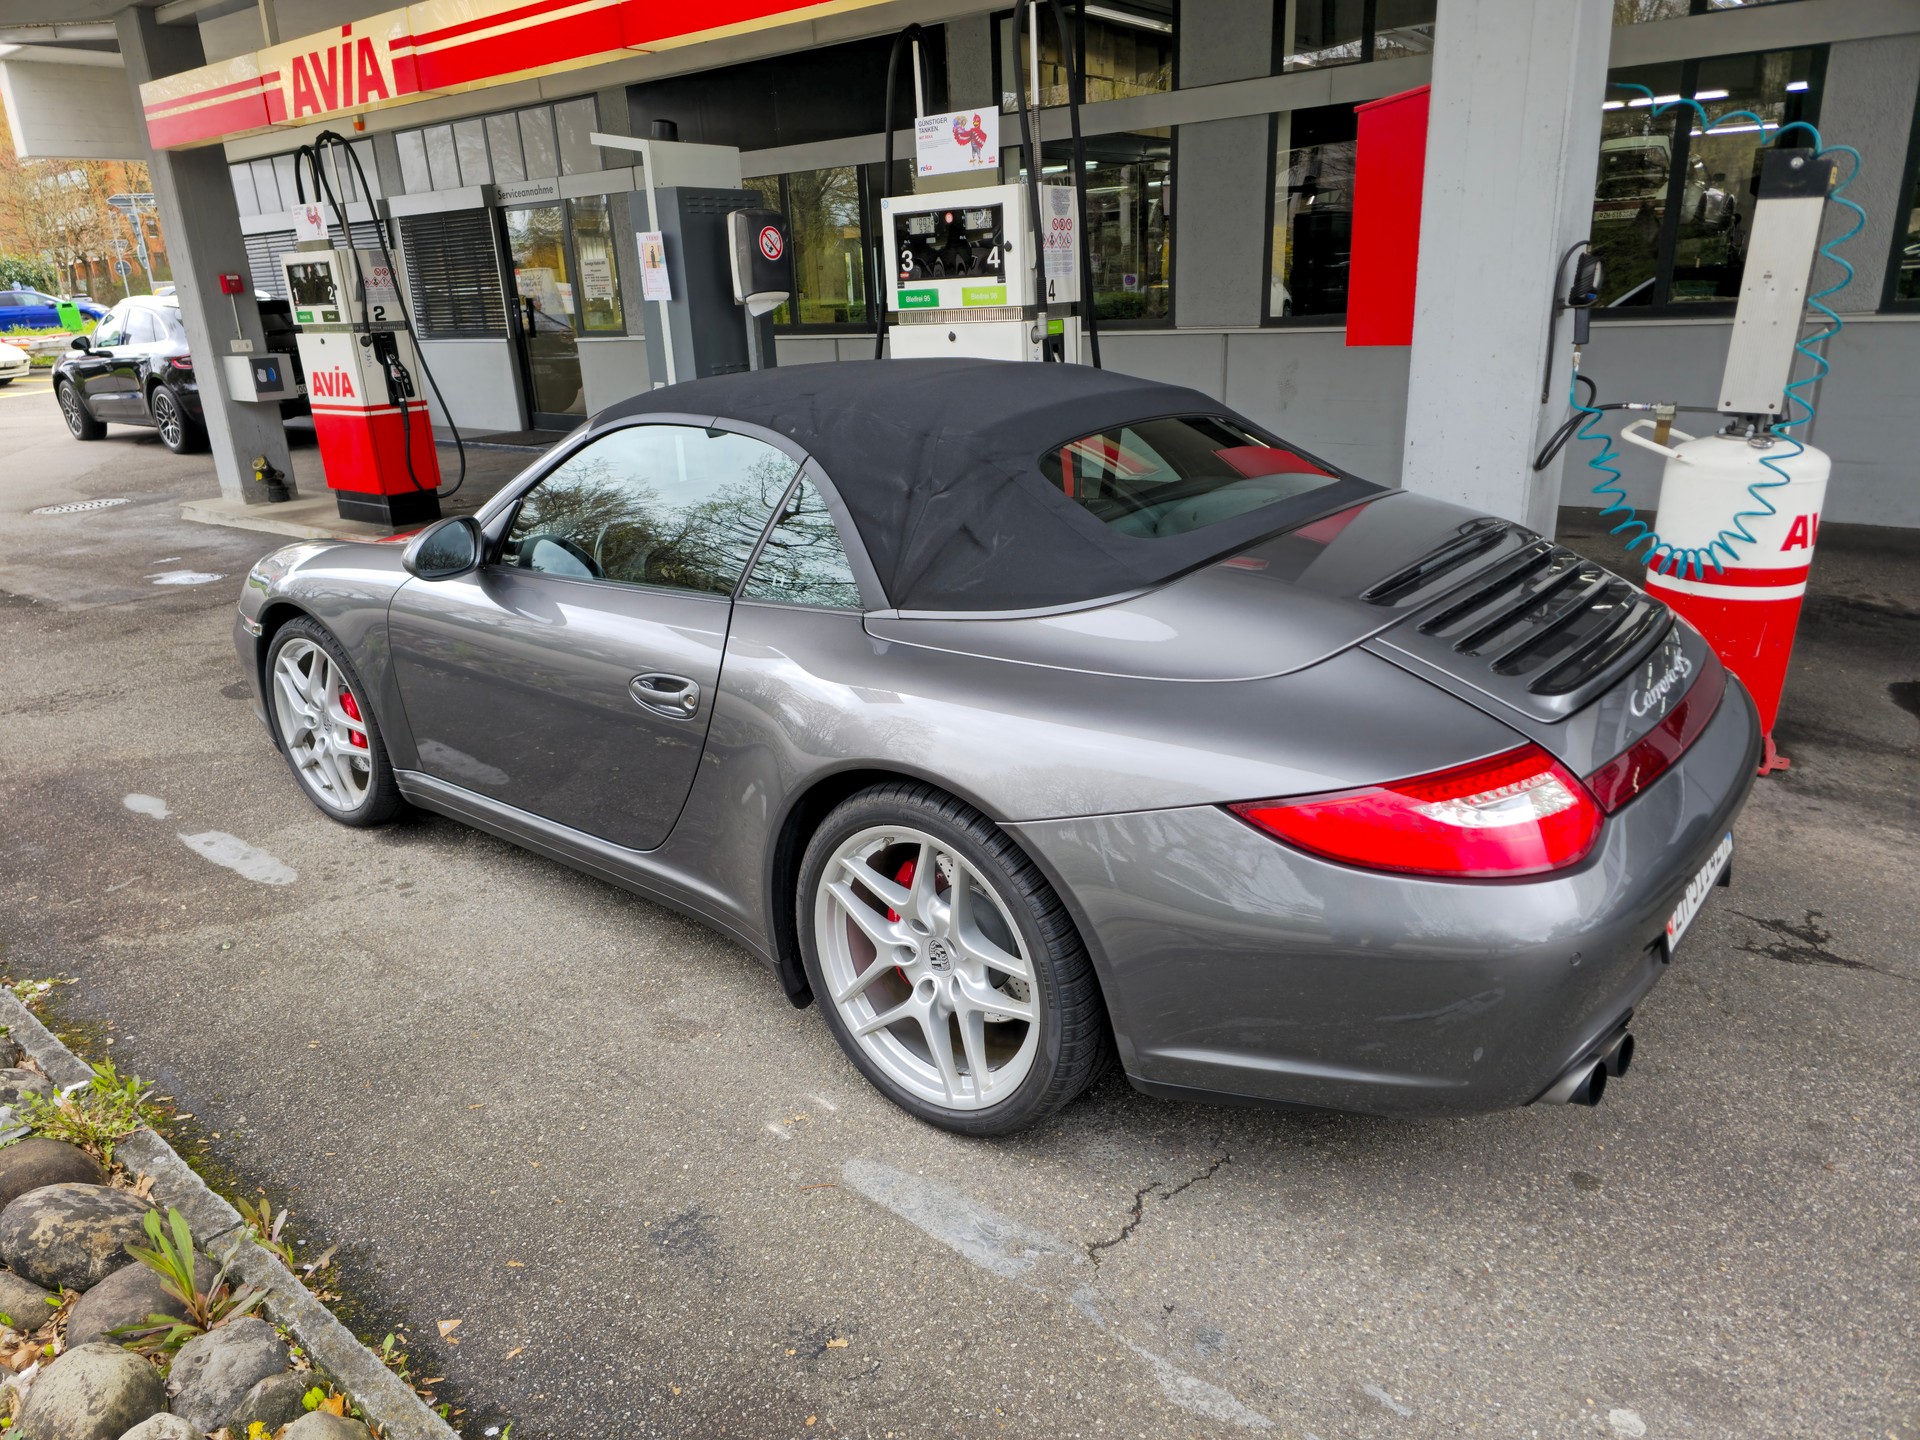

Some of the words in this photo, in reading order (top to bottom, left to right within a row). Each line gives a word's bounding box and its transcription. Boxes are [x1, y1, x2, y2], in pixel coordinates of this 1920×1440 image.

[292, 22, 390, 118] AVIA
[497, 184, 554, 200] Serviceannahme
[901, 250, 914, 271] 3
[987, 246, 1001, 268] 4
[293, 288, 299, 300] 1
[328, 286, 335, 300] 2
[1048, 279, 1056, 301] 4
[373, 305, 387, 321] 2
[312, 366, 355, 398] AVIA
[1630, 667, 1679, 717] Carrera
